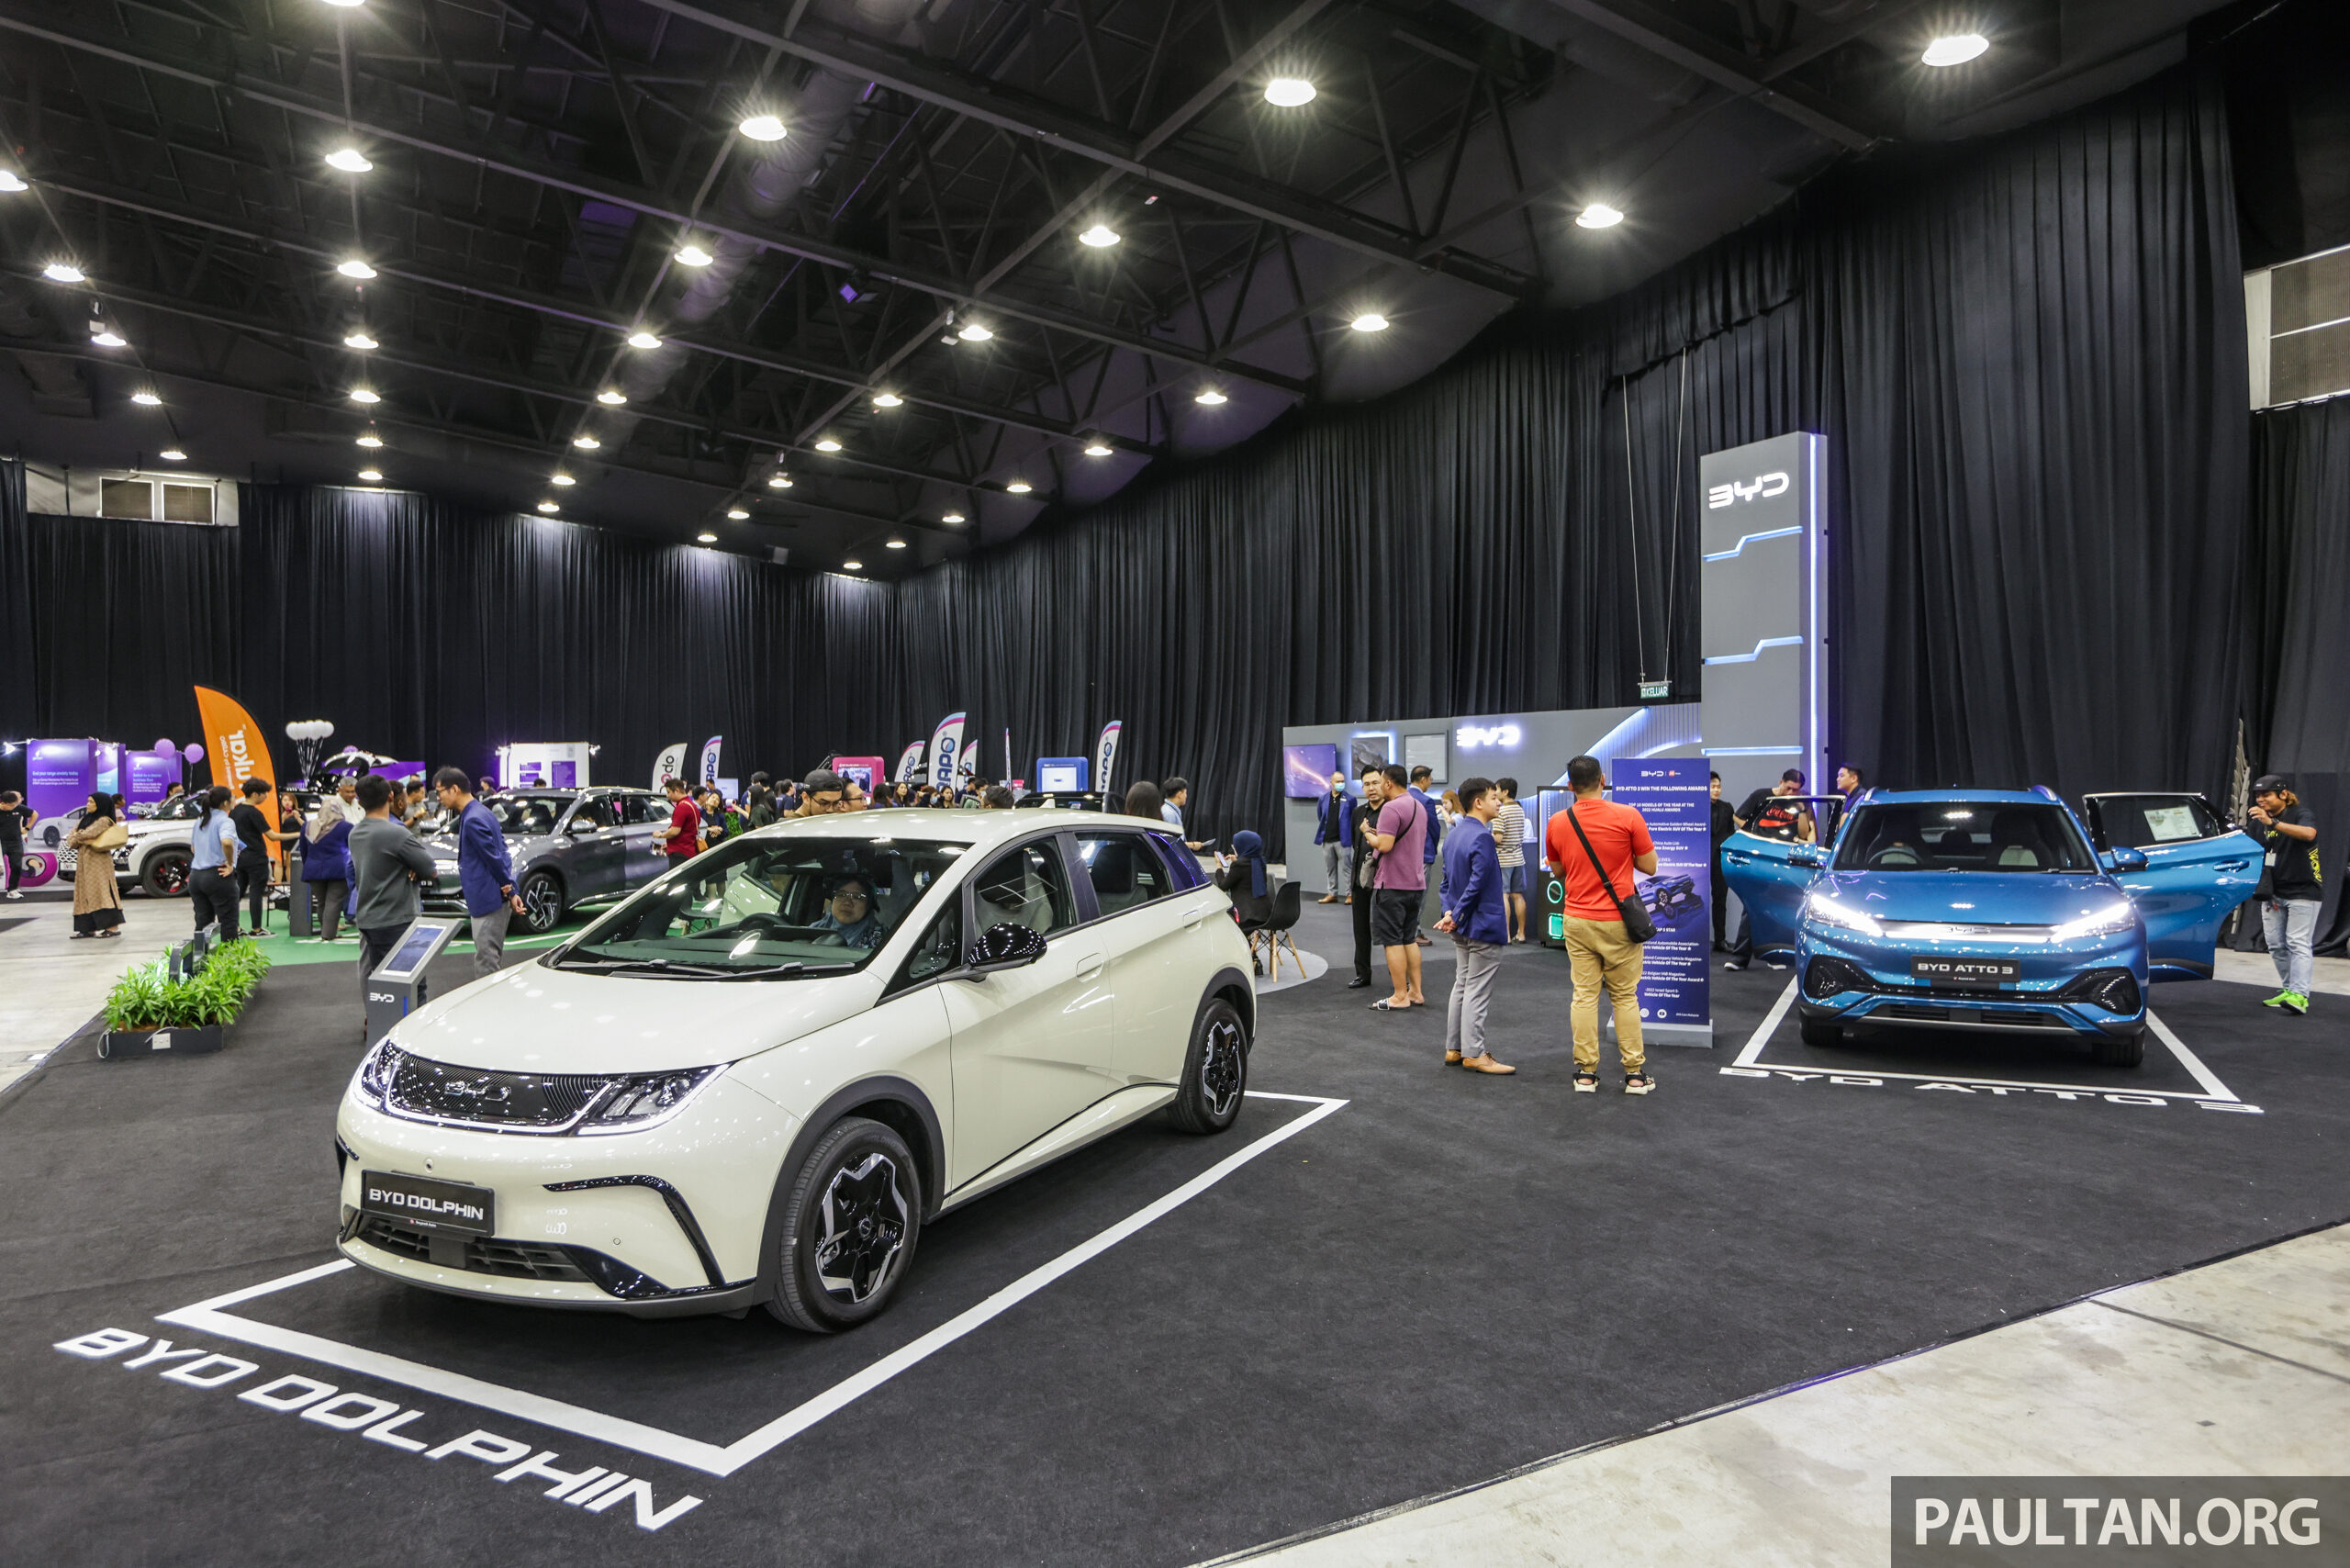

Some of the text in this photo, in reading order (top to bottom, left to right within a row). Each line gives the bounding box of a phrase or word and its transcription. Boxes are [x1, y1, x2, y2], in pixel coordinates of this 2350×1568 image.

[1709, 472, 1789, 509] BYD
[1646, 686, 1668, 697] KELUAR
[1457, 725, 1520, 747] BYD
[1918, 963, 2014, 975] BYD ATTO 3
[369, 992, 395, 1002] BYD
[1718, 1066, 2265, 1114] BYD ATTO 3
[369, 1188, 484, 1220] BYD DOLPHIN
[51, 1326, 704, 1531] BYD DOLPHIN
